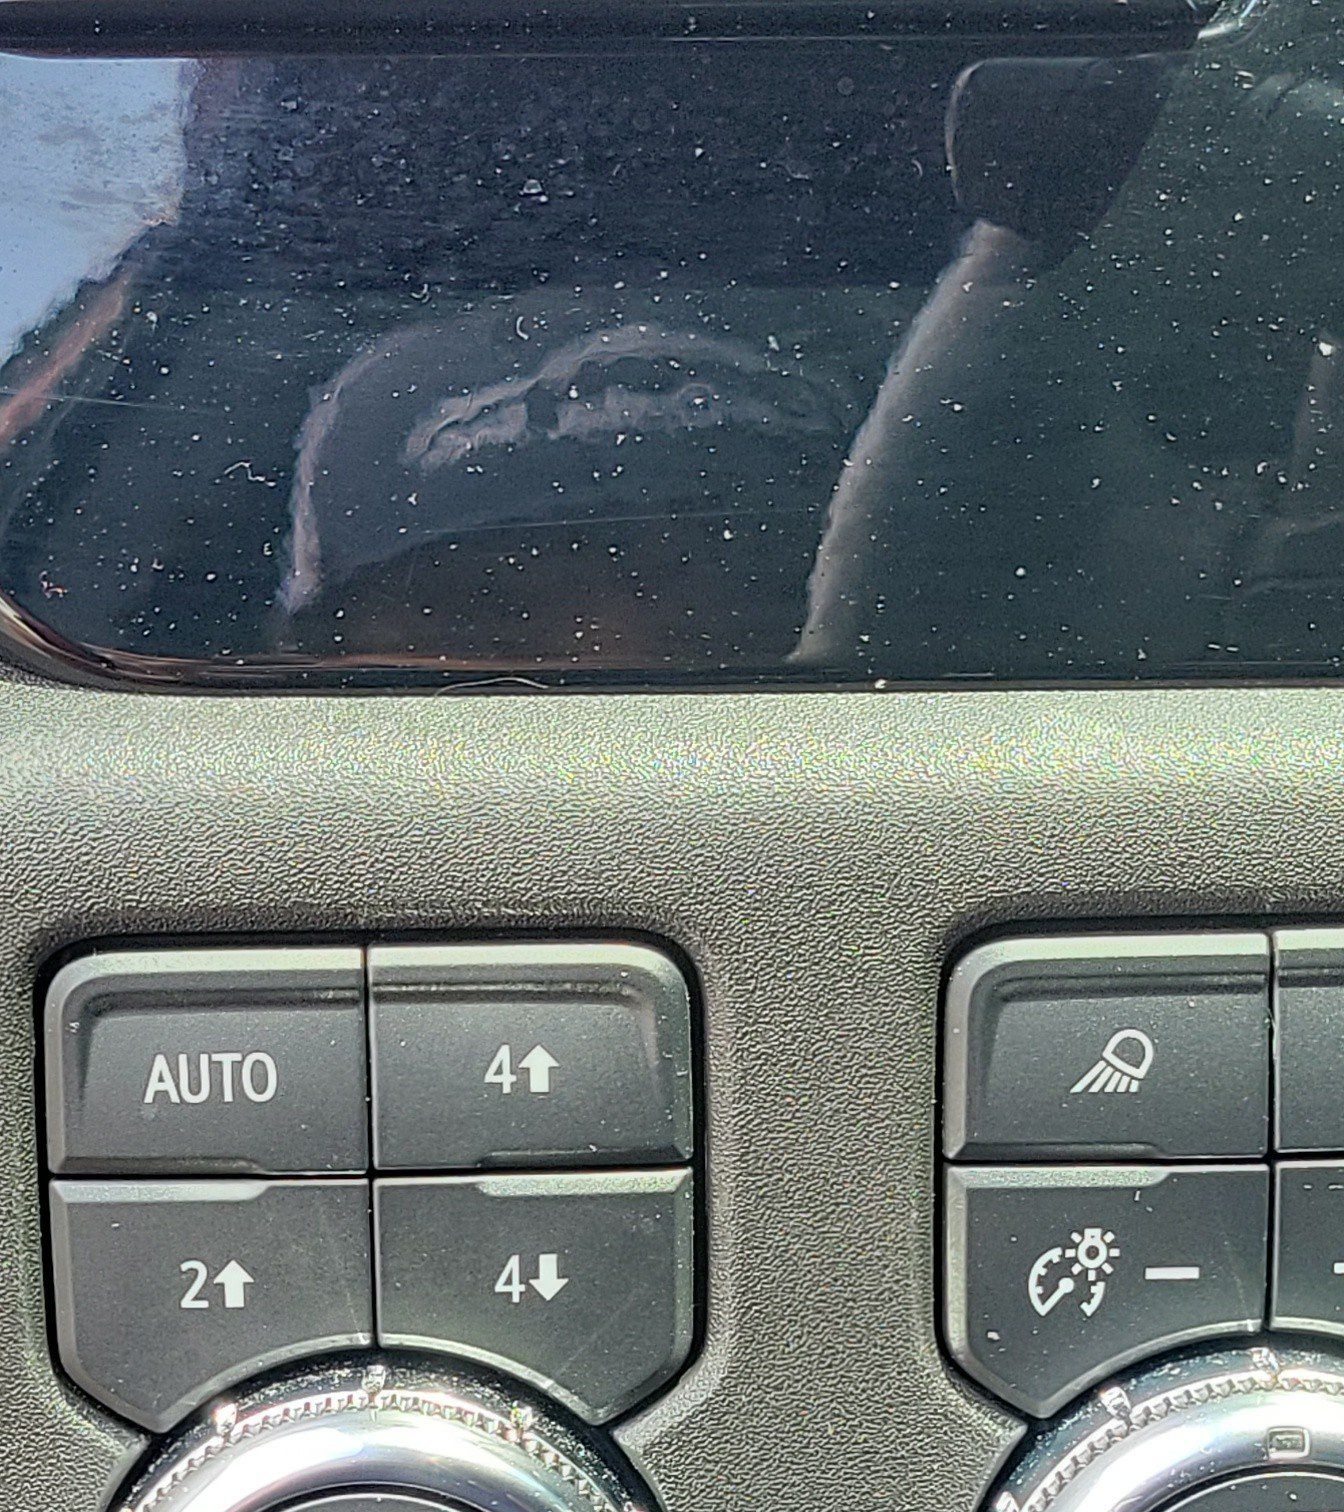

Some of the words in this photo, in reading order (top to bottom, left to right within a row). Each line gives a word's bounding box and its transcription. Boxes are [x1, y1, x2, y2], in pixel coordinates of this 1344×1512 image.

[142, 1050, 279, 1105] AUTO
[482, 1043, 519, 1095] 4
[178, 1258, 211, 1310] 2
[493, 1253, 527, 1305] 4
